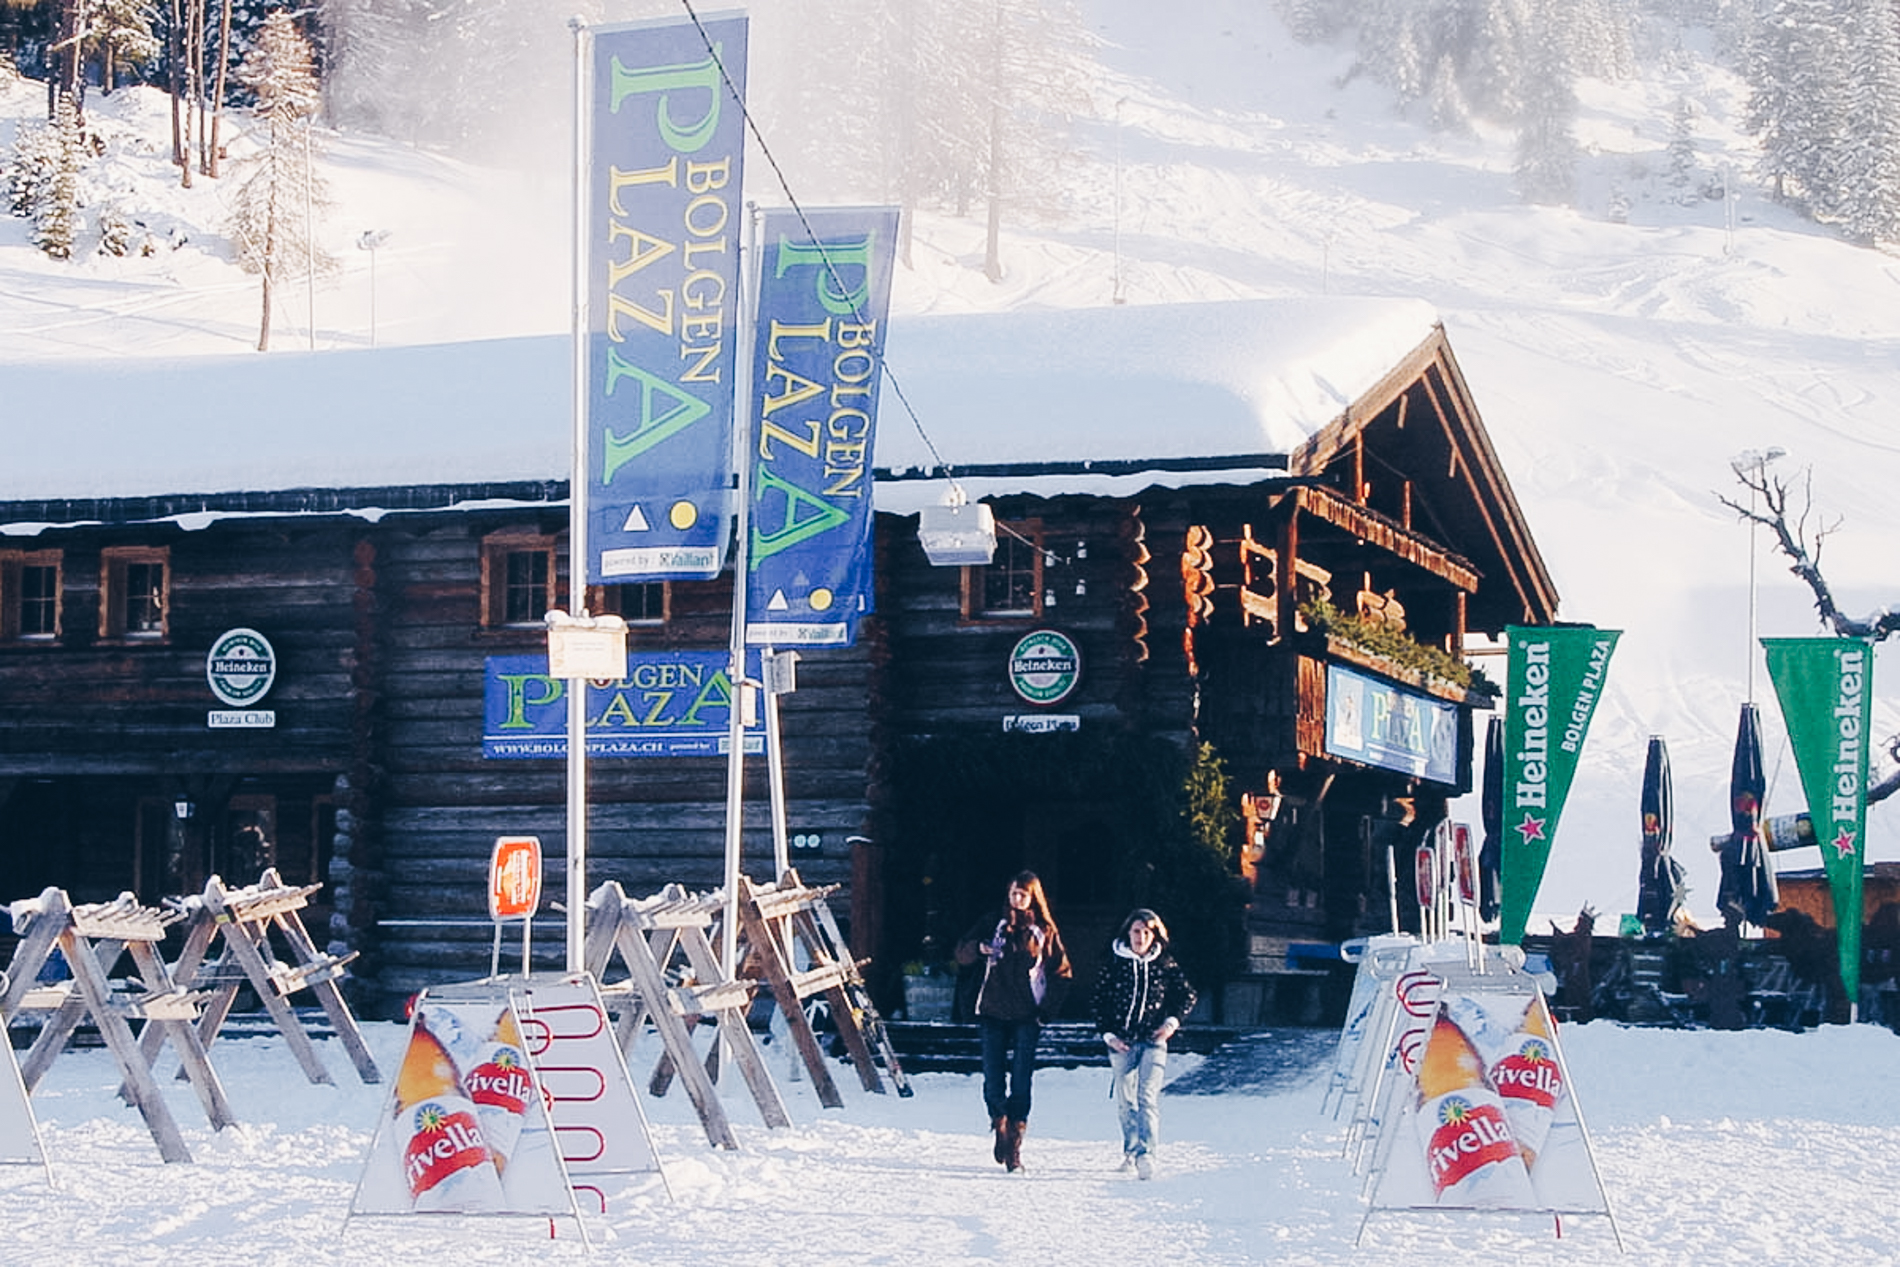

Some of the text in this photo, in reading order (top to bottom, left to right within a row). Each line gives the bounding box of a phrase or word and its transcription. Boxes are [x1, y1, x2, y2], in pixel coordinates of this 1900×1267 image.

[602, 41, 722, 486] PLAZA
[679, 155, 731, 384] BOLGEN
[750, 229, 876, 571] PLAZA
[822, 318, 877, 498] BOLGEN
[211, 712, 273, 725] Plaza Club
[214, 660, 268, 673] Heineken
[498, 670, 761, 729] PAZA
[1014, 658, 1072, 673] Heineken
[1516, 640, 1550, 809] Heineken
[1561, 640, 1610, 753] BOLGEN PLAZA
[1832, 649, 1863, 823] Heineken
